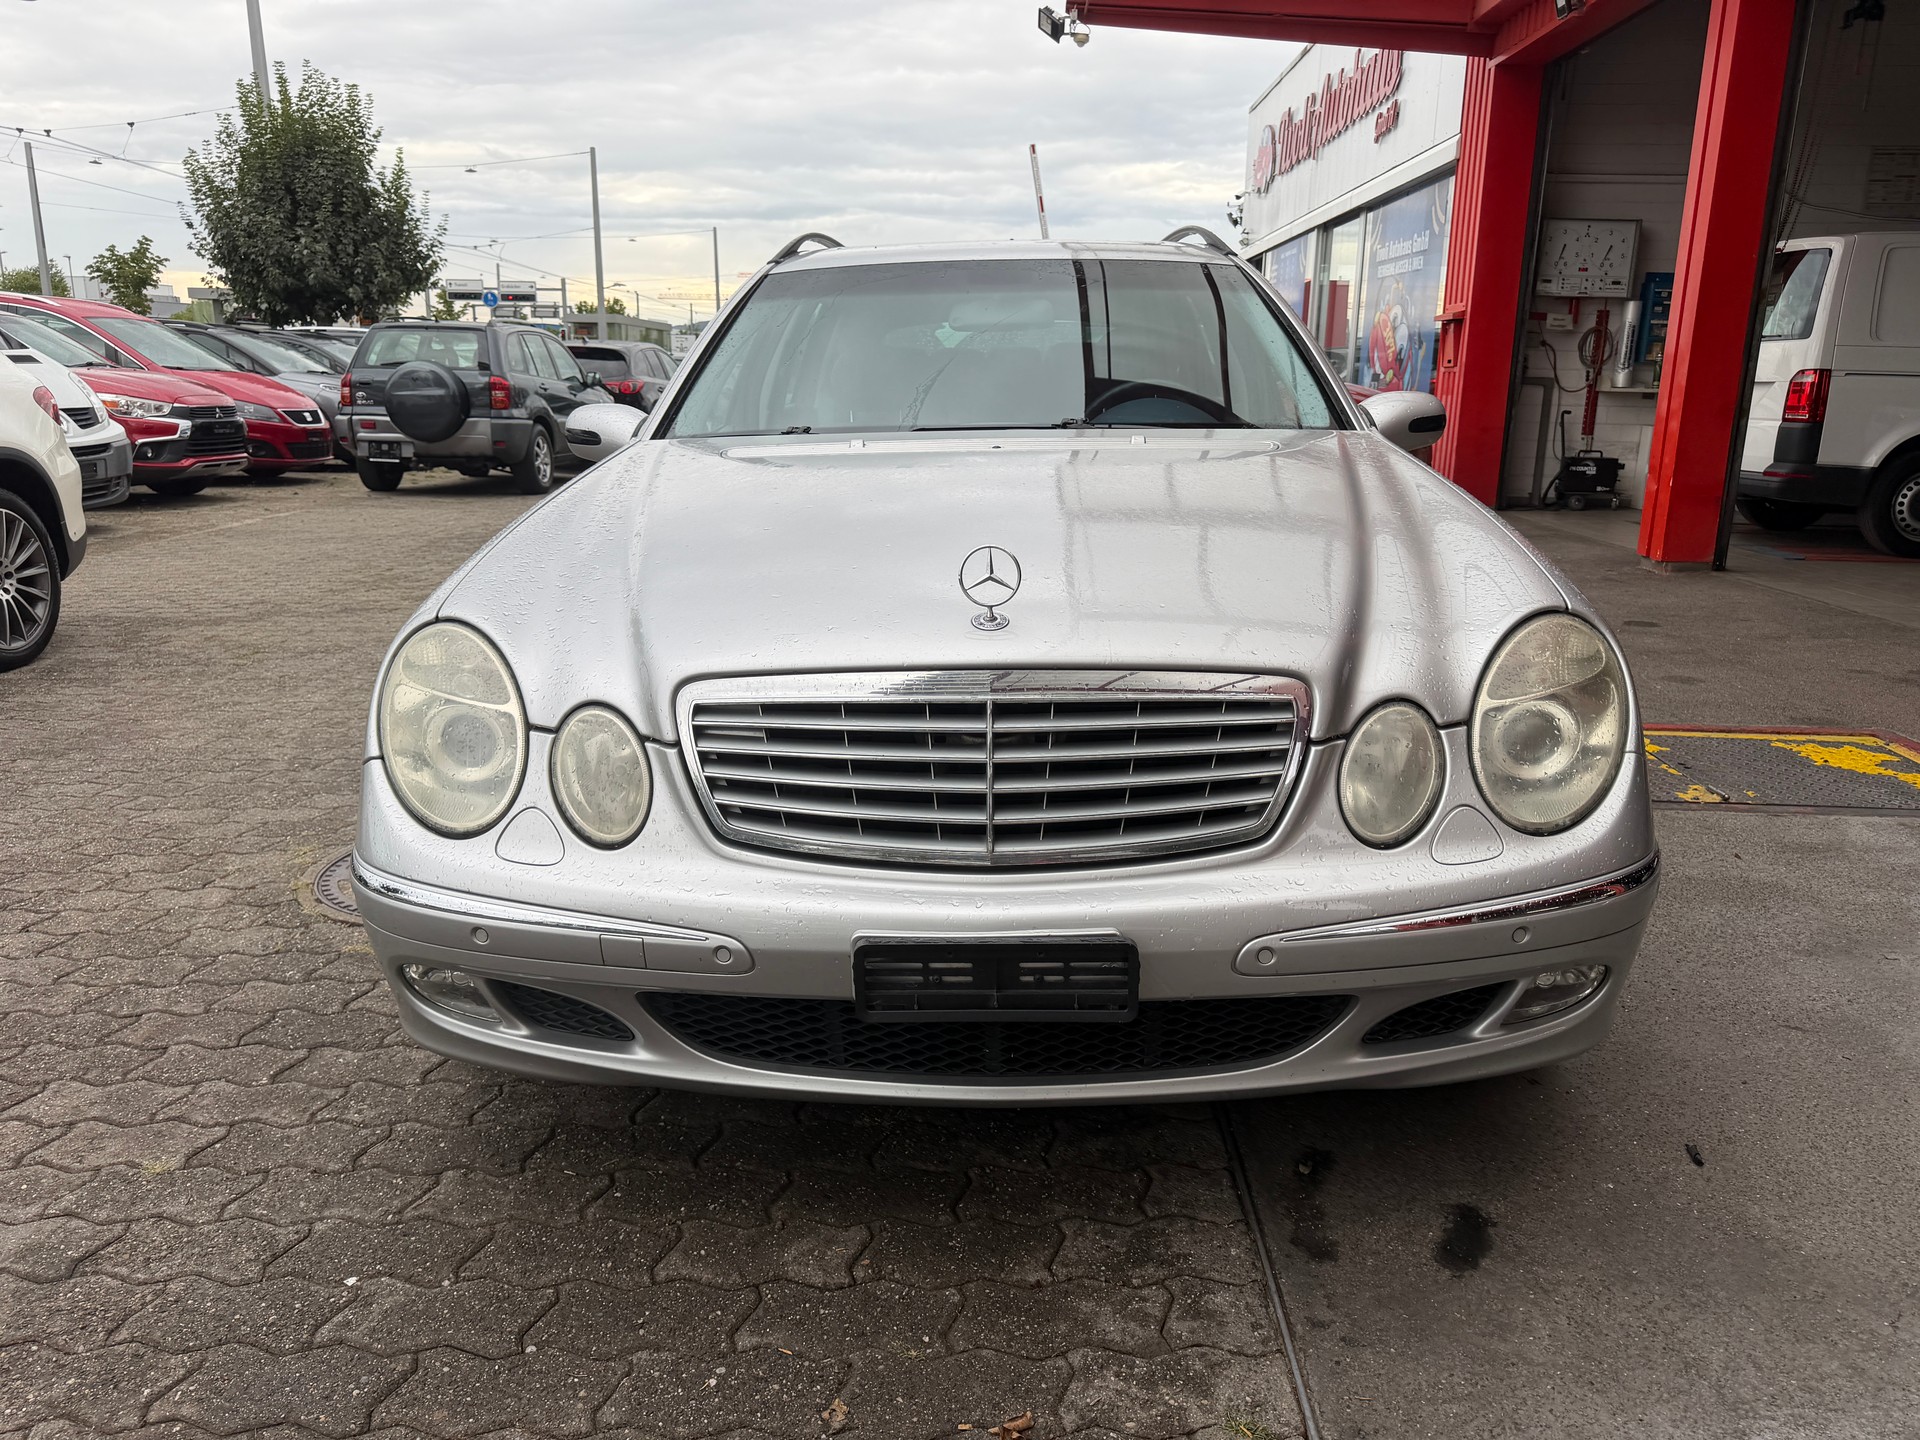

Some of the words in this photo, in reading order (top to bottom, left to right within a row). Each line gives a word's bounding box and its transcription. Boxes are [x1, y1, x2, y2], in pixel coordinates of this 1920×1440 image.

[1278, 92, 1315, 176] Tivoli
[1312, 48, 1402, 160] Autohaus
[1389, 237, 1412, 259] Autohaus
[1412, 230, 1429, 252] GmbH
